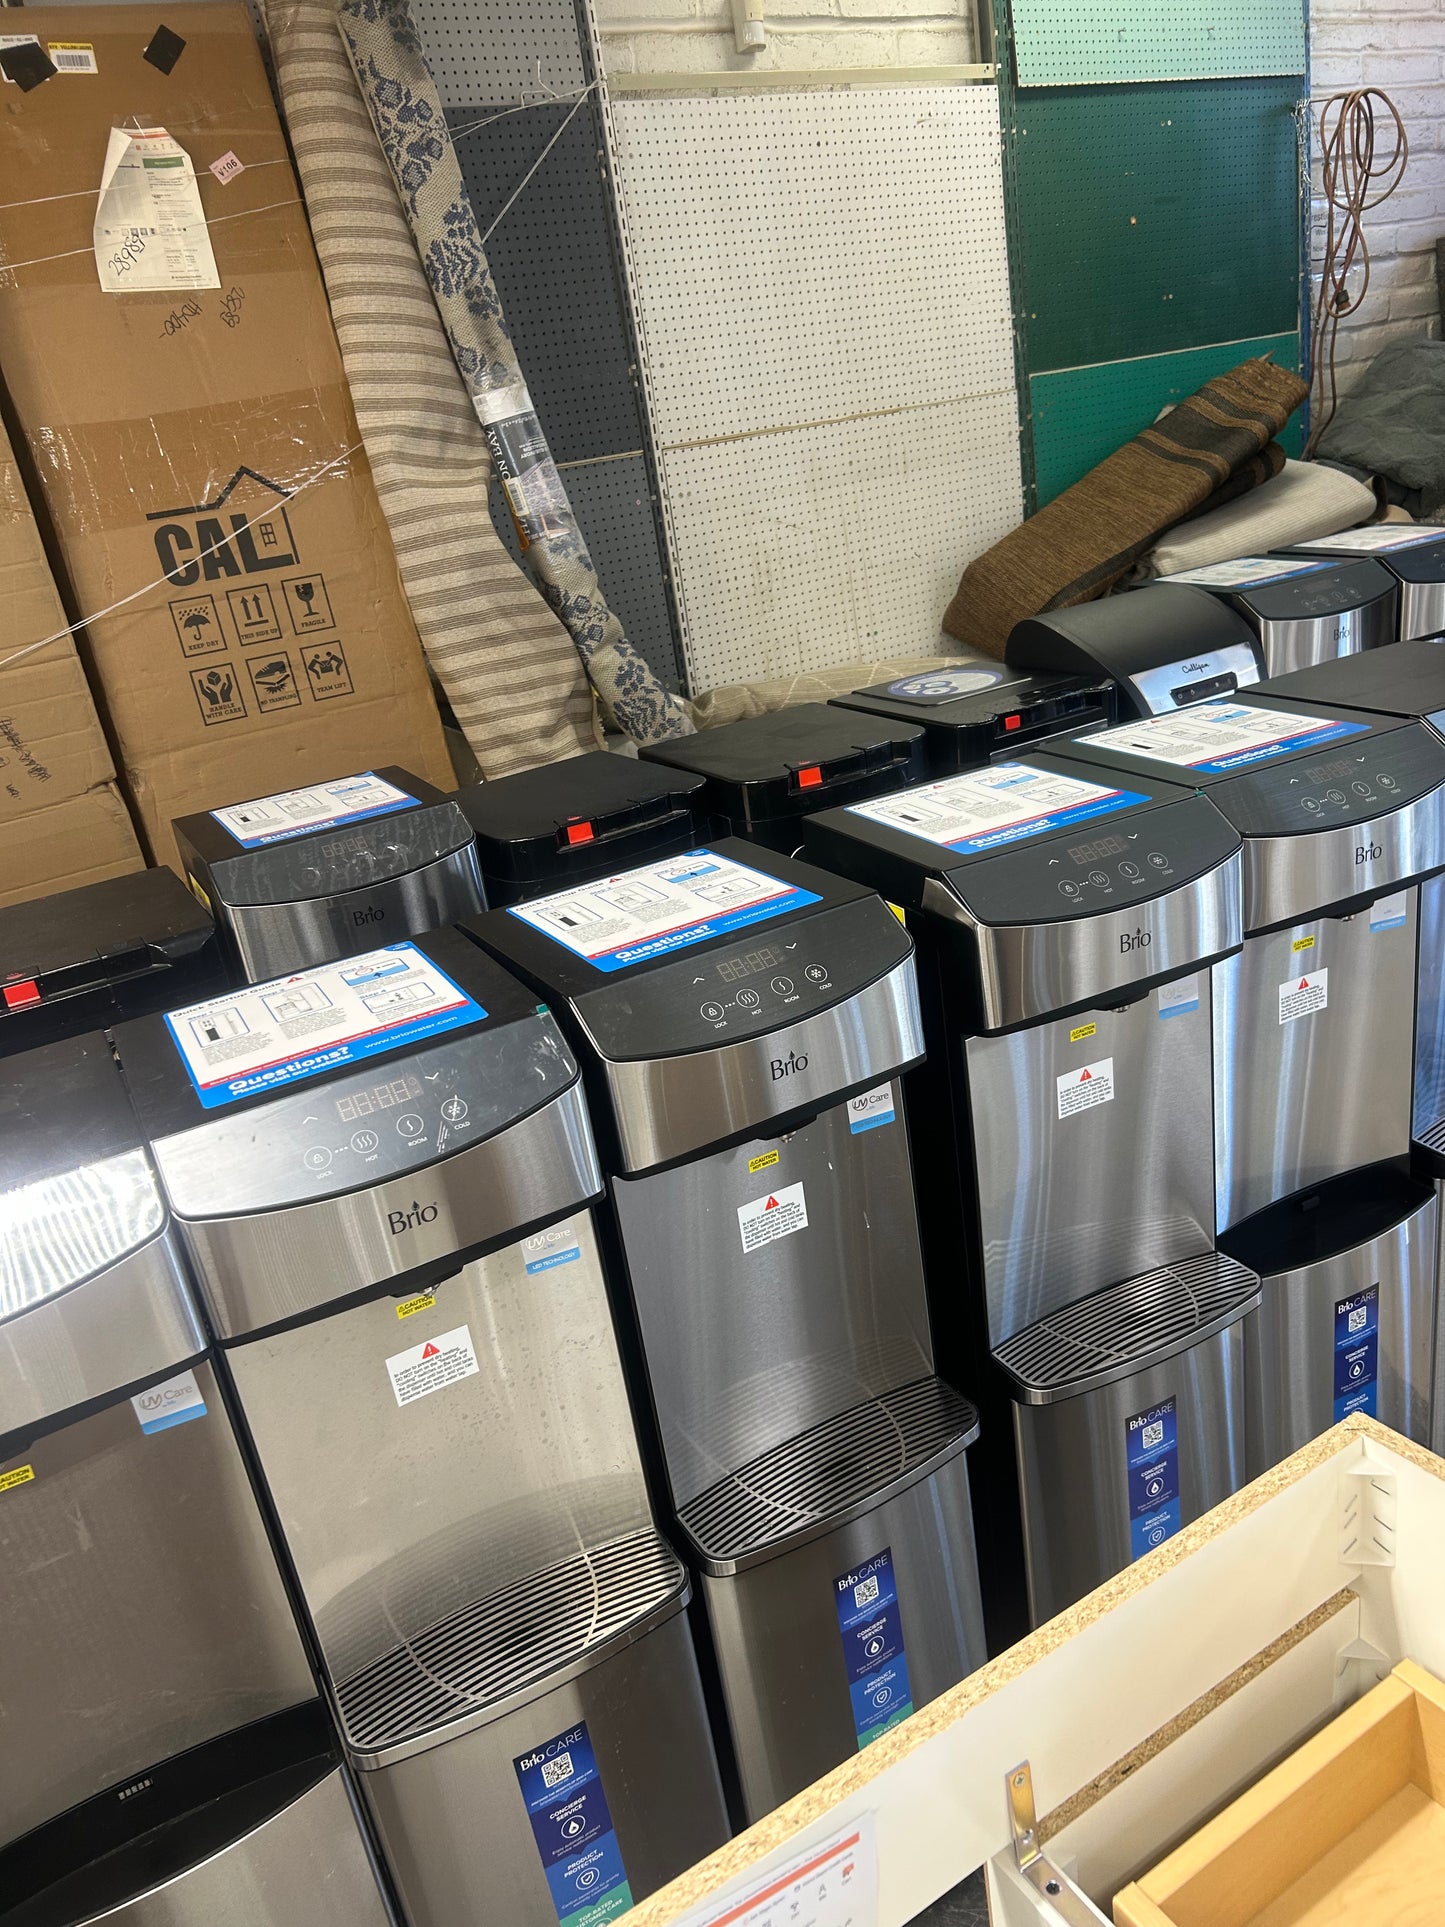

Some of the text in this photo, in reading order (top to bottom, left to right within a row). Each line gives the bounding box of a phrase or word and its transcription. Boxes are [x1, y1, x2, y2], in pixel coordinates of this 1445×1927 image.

[218, 158, 238, 176] V106
[108, 234, 145, 276] 28989
[486, 428, 502, 456] BAY
[154, 513, 294, 587] CAL
[301, 618, 326, 628] FRAGILE
[1333, 625, 1350, 641] Brio
[1182, 663, 1210, 674] Culligan
[206, 708, 242, 720] WITH CARE
[209, 702, 234, 712] HANDLE
[965, 818, 1054, 845] Questions?
[1354, 840, 1382, 865] Brio
[1131, 877, 1146, 885] ROOM
[353, 905, 384, 928] Brio
[612, 924, 713, 960] Questions?
[1120, 927, 1152, 954] Brio
[172, 981, 281, 1017] Quick Startup Guide
[714, 982, 832, 1030] LOCK HOT ROOM COLD
[363, 1015, 458, 1049] www.briowater.com
[1076, 1024, 1095, 1034] CAUTION
[227, 1045, 351, 1092] Questions?
[770, 1050, 808, 1080] Brio
[231, 1080, 268, 1095] Please
[268, 1073, 291, 1083] visit
[291, 1067, 310, 1076] our
[853, 1092, 889, 1110] UV Care
[316, 1121, 471, 1180] LOCK HOT ROOM COLD
[754, 1152, 777, 1165] CAUTION
[762, 1158, 776, 1167] WATER
[387, 1200, 438, 1236] Brio
[526, 1228, 571, 1250] UV Care
[532, 1252, 576, 1270] LED TECHNOLOGY
[402, 1300, 432, 1316] HOT WATER
[404, 1295, 433, 1310] CAUTION
[1338, 1289, 1376, 1314] Brio CARE
[399, 1367, 411, 1375] order
[417, 1357, 433, 1367] prevent
[403, 1371, 413, 1379] NOT
[417, 1366, 436, 1378] switches
[451, 1355, 461, 1363] back
[163, 1385, 193, 1401] Care
[399, 1389, 410, 1397] have
[401, 1390, 420, 1401] dispense
[421, 1384, 433, 1392] water
[445, 1373, 457, 1382] water
[406, 1377, 425, 1388] dispenser
[1130, 1402, 1174, 1431] Brio CARE
[0, 1468, 30, 1484] AUTION
[1140, 1461, 1168, 1478] CONCIERGE
[1144, 1468, 1164, 1480] SERVICE
[7, 1475, 30, 1486] WATER
[1142, 1515, 1171, 1532] PROTECTION
[838, 1554, 888, 1592] Brio CARE
[856, 1617, 887, 1639] CONCIERGE
[862, 1624, 884, 1641] SERVICE
[864, 1672, 896, 1695] PROTECTION
[866, 1670, 892, 1689] PRODUCT
[520, 1728, 584, 1772] Brio CARE
[549, 1794, 587, 1820] CONCIERGE
[556, 1804, 584, 1822] SERVICE
[564, 1852, 604, 1878] PROTECTION
[567, 1849, 598, 1870] PRODUCT
[578, 1899, 614, 1924] TOP-RATED
[603, 1898, 624, 1916] CARE
